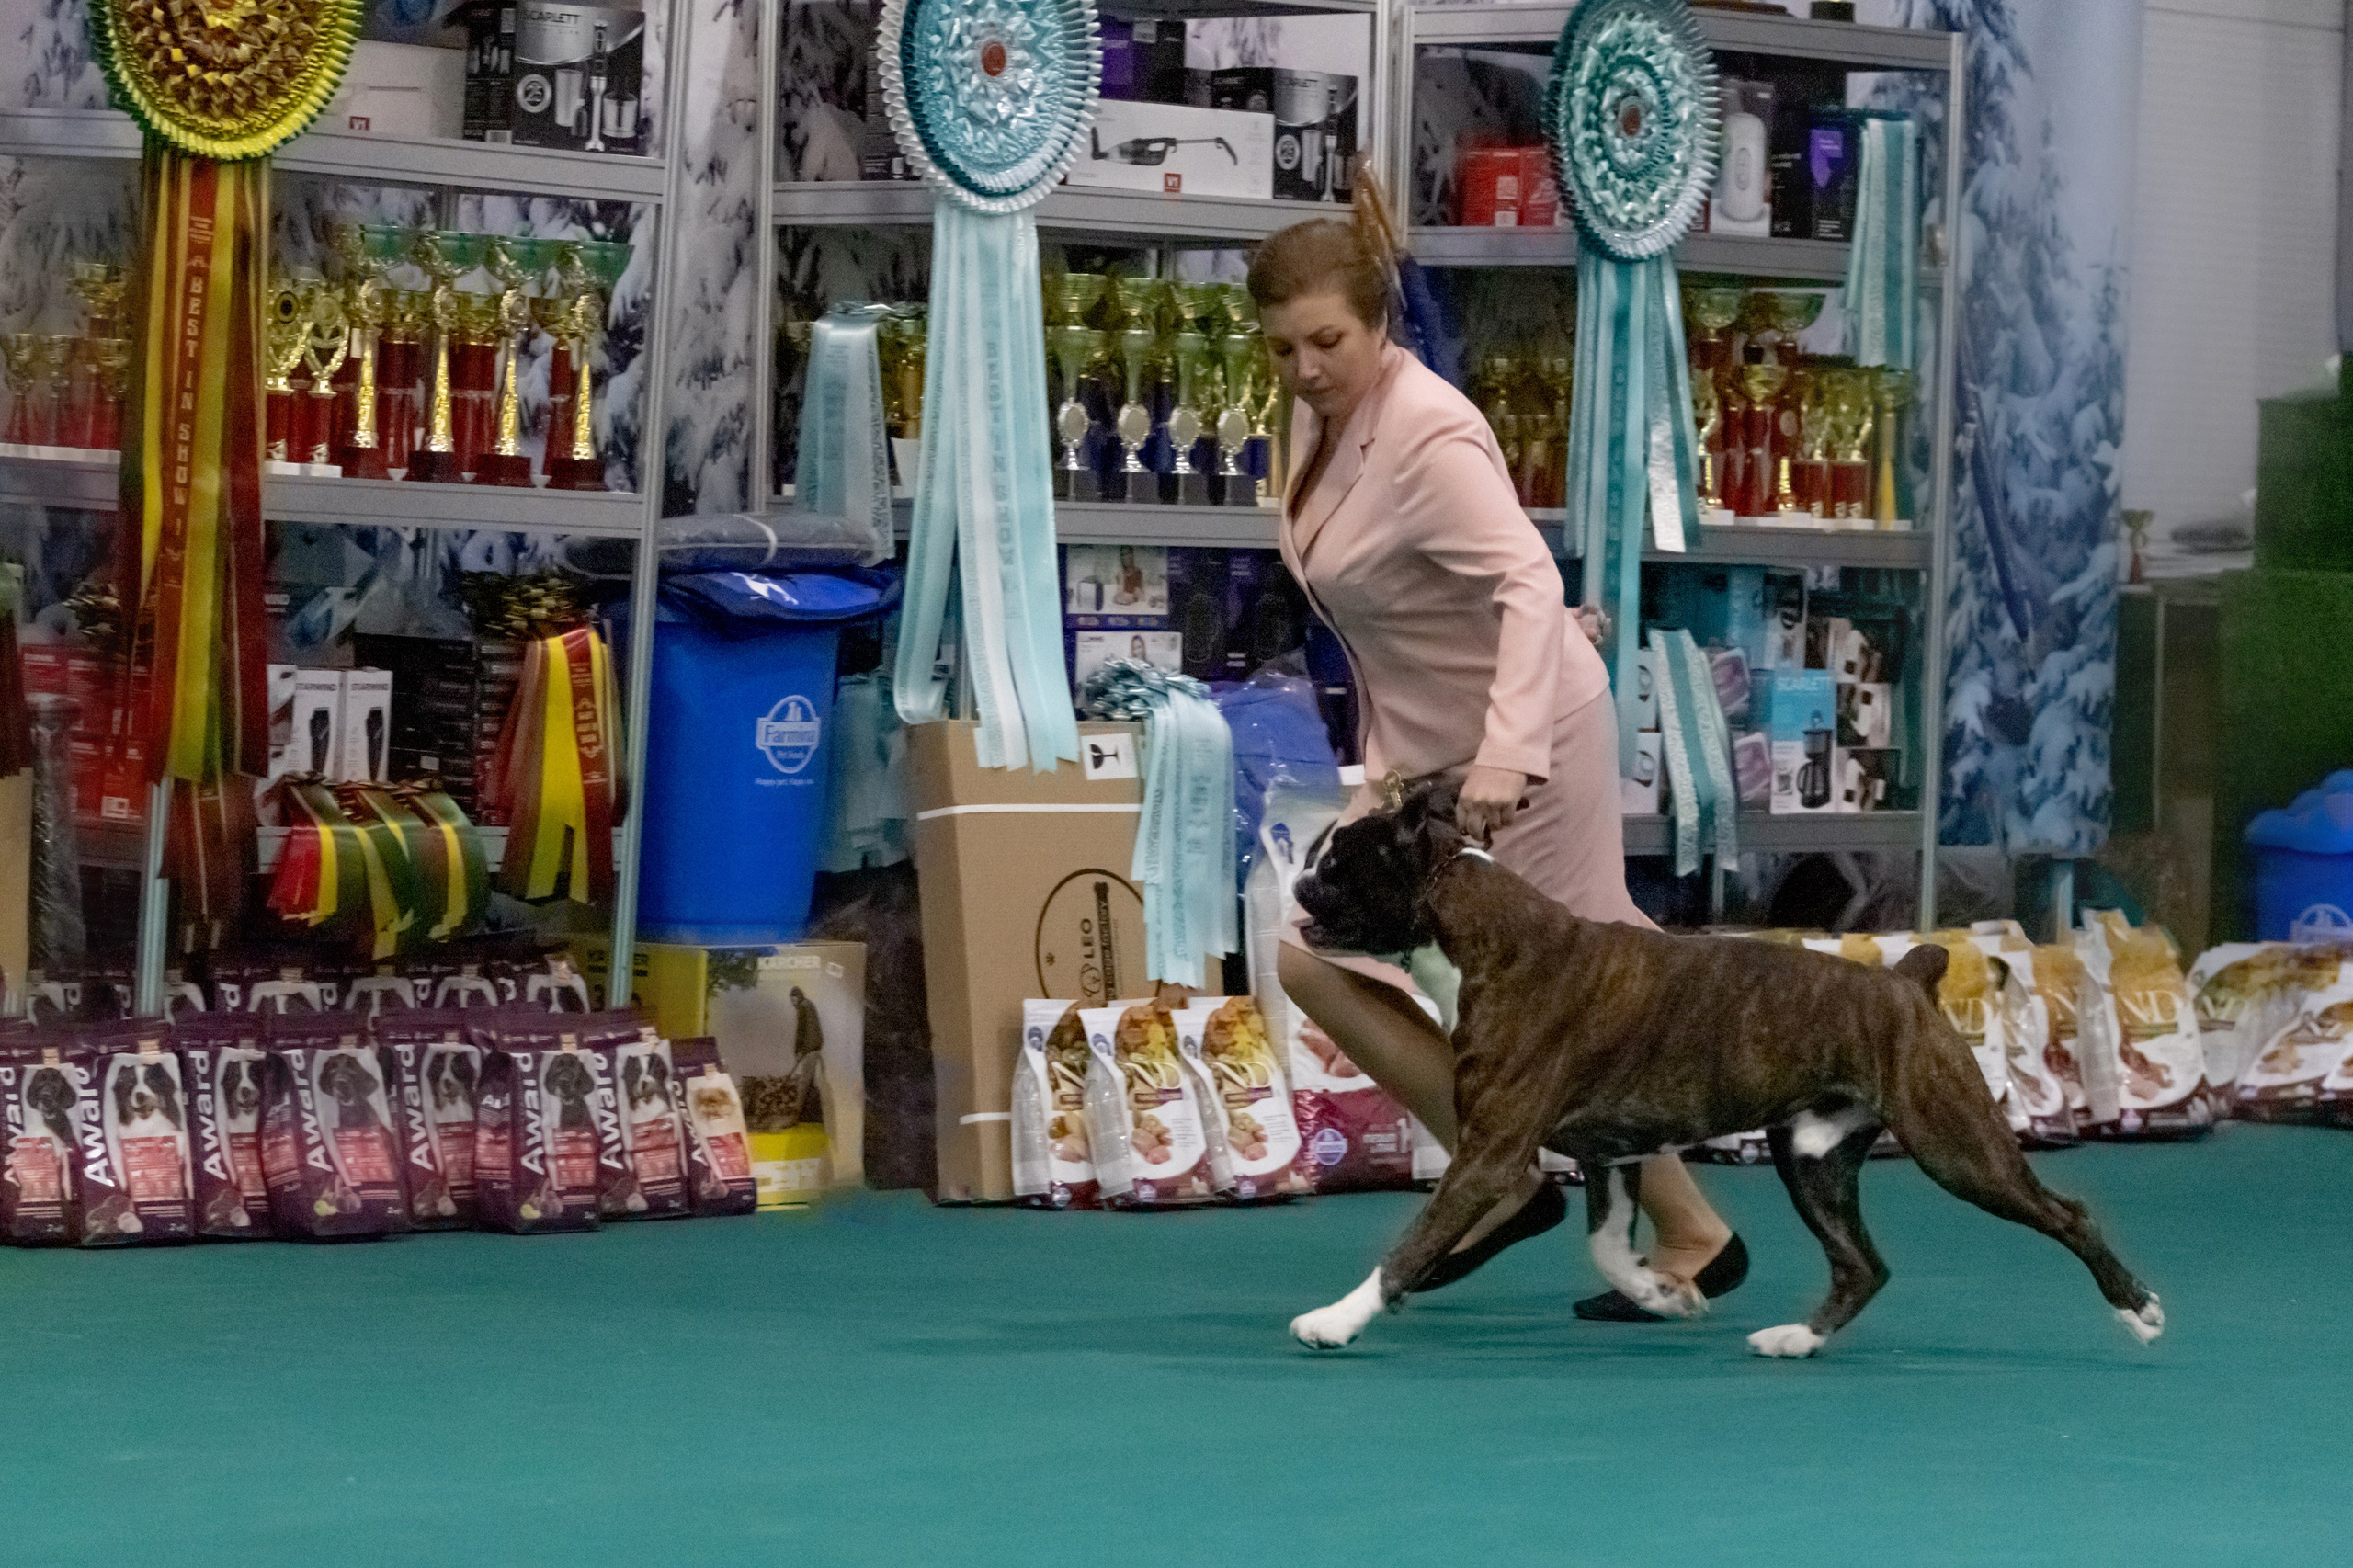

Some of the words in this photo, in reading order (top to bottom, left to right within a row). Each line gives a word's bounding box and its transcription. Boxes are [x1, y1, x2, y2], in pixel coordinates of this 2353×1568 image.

[187, 277, 203, 358] BEST
[181, 370, 194, 410] IN
[174, 423, 191, 505] SHOW
[296, 683, 337, 691] STARWIND
[764, 724, 816, 743] Farmina
[1080, 918, 1095, 959] LEO
[188, 1051, 228, 1180] Award
[281, 1049, 334, 1172] Award
[394, 1044, 434, 1171] Award
[510, 1052, 554, 1175] Award
